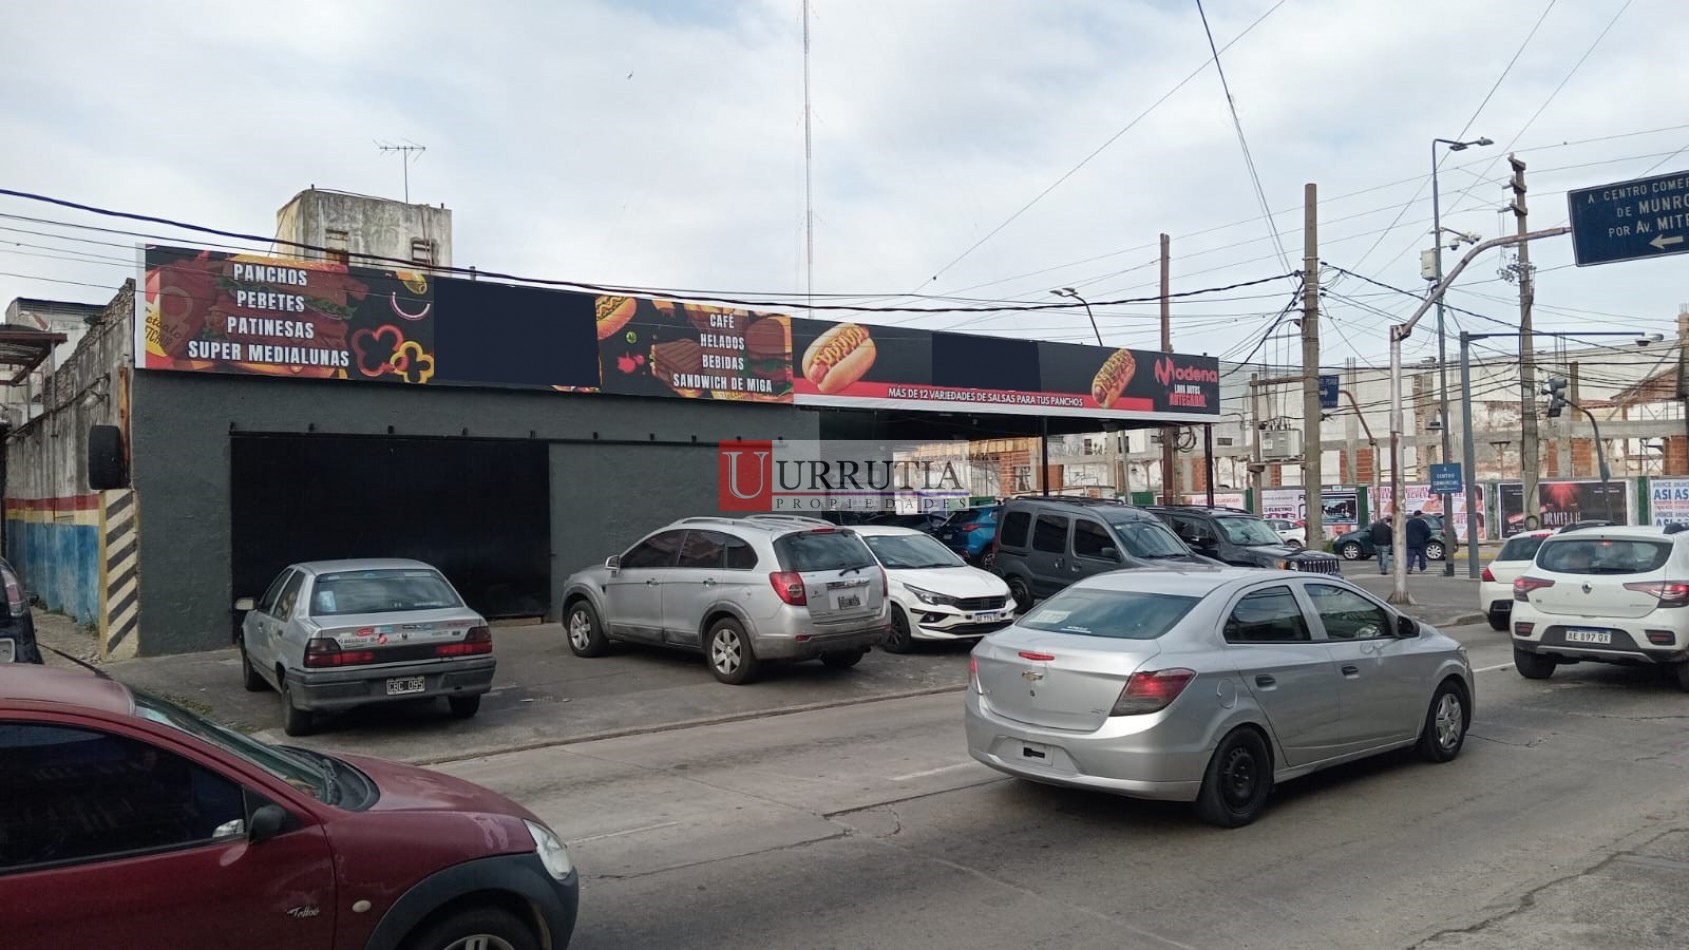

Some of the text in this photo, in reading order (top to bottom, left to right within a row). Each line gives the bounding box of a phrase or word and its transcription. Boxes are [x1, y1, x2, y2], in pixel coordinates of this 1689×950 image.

[1588, 194, 1595, 204] A
[1603, 185, 1647, 201] CENTRO
[1617, 206, 1632, 218] DE
[1608, 226, 1630, 238] POR
[233, 263, 308, 286] PANCHOS
[236, 290, 305, 312] PEBETES
[227, 315, 314, 339] PATINESAS
[709, 313, 735, 329] CAFÉ
[700, 333, 745, 350] HELADOS
[188, 340, 350, 367] SUPER MEDIALUNAS
[702, 354, 744, 370] BEBIDAS
[1155, 356, 1217, 387] Modena
[673, 373, 773, 393] SANDWICH DE MIGA
[888, 385, 1083, 407] MÁS DE 12 VARIEDADES DE SALSAS PARA TUS PANCHOS
